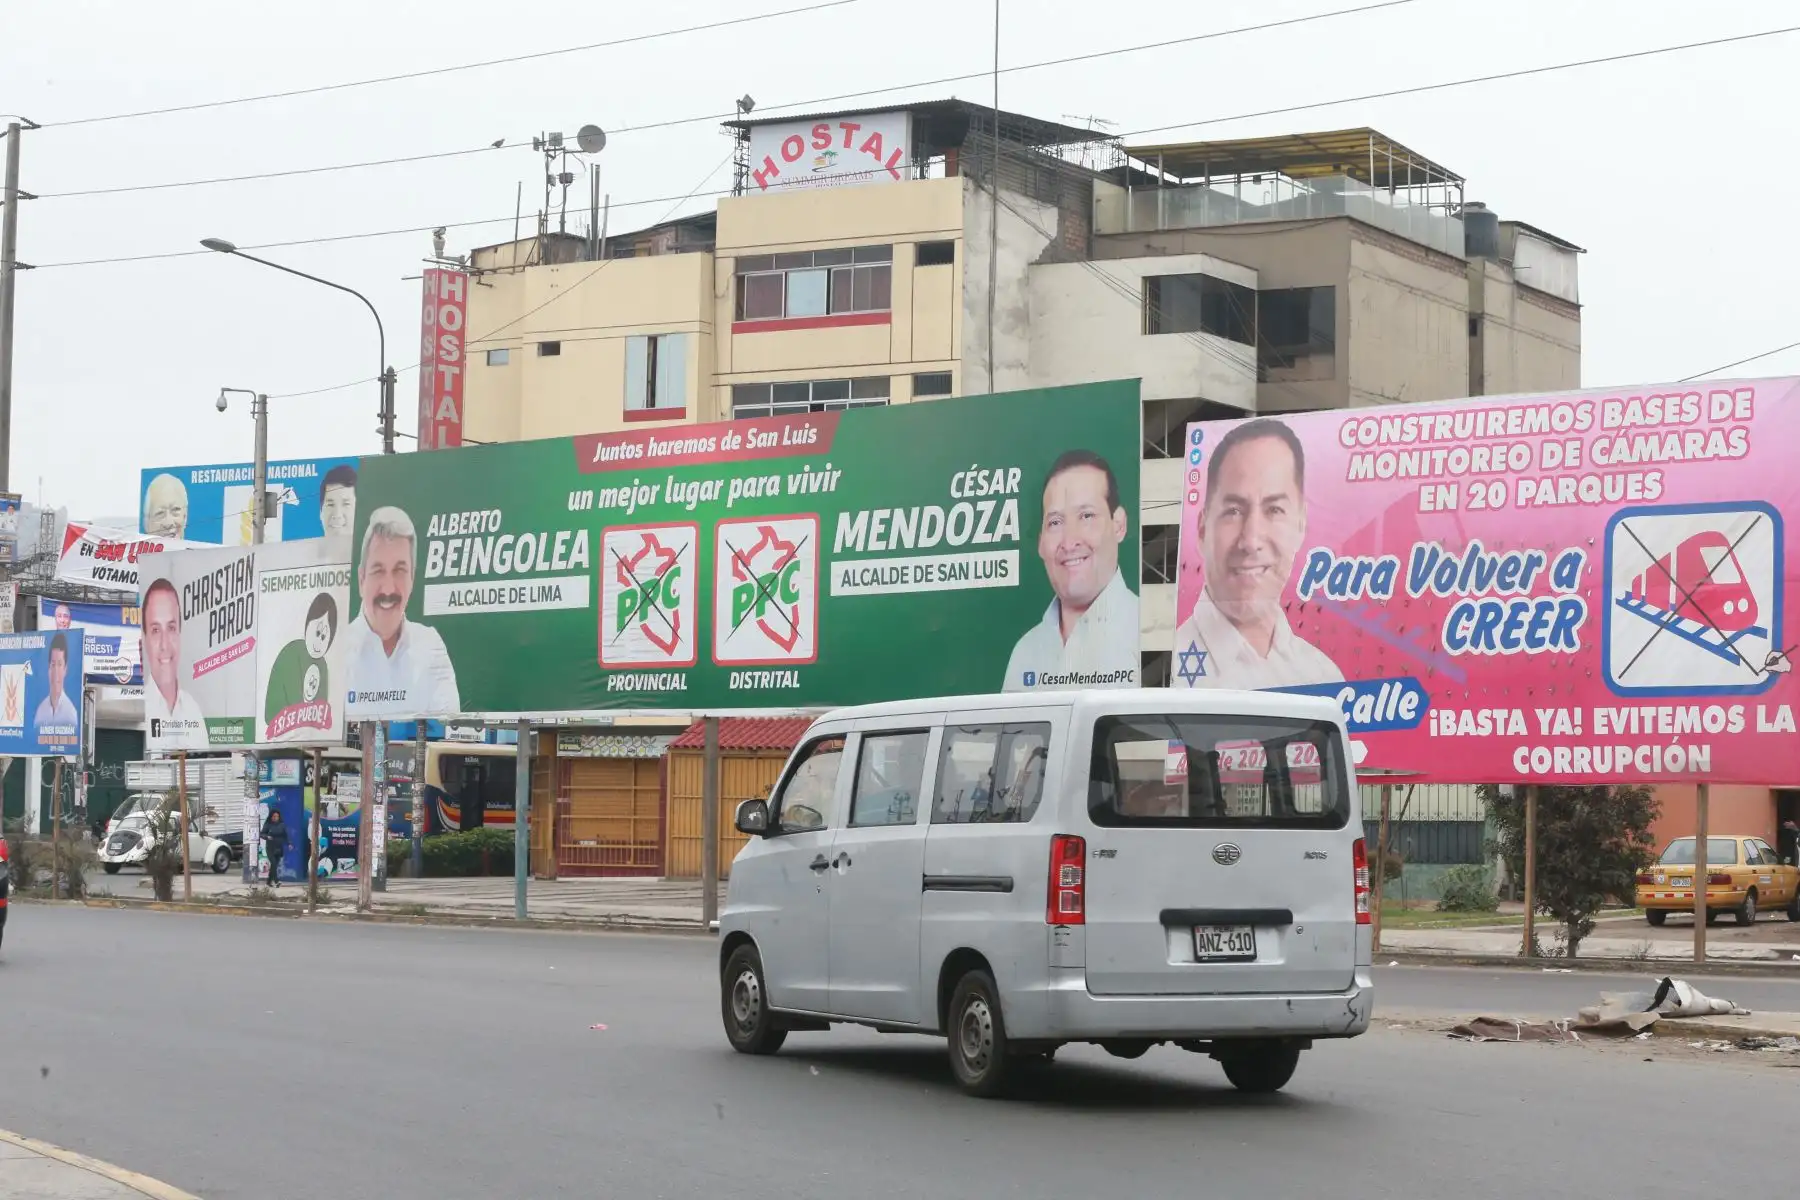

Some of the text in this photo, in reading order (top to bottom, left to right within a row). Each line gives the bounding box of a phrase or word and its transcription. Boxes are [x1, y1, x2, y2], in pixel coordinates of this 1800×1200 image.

[752, 122, 904, 191] HOSTAL
[435, 273, 464, 450] HOSTAL
[1340, 391, 1754, 446] CONSTRUIREMOS BASES DE
[593, 423, 818, 463] Juntos haremos de San Luis
[1347, 430, 1749, 482] MONITOREO DE CÁMARAS
[191, 463, 318, 484] RESTAURACI NACIONAL
[568, 462, 842, 515] un mejor lugar para vivir
[950, 464, 1021, 499] CÉSAR
[1419, 472, 1663, 512] EN 20 PARQUES
[427, 509, 502, 537] ALBERTO
[833, 499, 1020, 553] MENDOZA
[80, 543, 94, 557] EN
[424, 529, 590, 578] BEINGOLEA
[92, 566, 140, 585] VOTAMO
[183, 553, 256, 621] CHRISTIAN
[261, 569, 351, 593] SIEMPRE UNIDOS
[841, 559, 1009, 588] ALCALDE DE SAN LUIS
[1299, 543, 1583, 598] Para Volver a
[448, 584, 562, 607] ALCALDE DE LIMA
[616, 566, 681, 633] PPC
[732, 560, 801, 628] PPC
[208, 592, 255, 648] PARDO
[1446, 600, 1586, 652] CREER
[85, 645, 113, 654] RRESTI
[198, 642, 250, 672] ALCALDE DE SAN LUIS
[607, 673, 687, 691] PROVINCIAL
[729, 671, 800, 689] DISTRITAL
[1038, 669, 1134, 686] /CesarMendozaPPC
[286, 711, 297, 728] SE
[297, 704, 329, 726] PUEDE!
[1336, 682, 1419, 724] Calle
[1430, 705, 1796, 738] ¡BASTA YA! EVITEMOS LA
[161, 719, 184, 729] Christian
[1512, 736, 1711, 775] CORRUPCIÓN
[1199, 932, 1252, 952] ANZ-610
